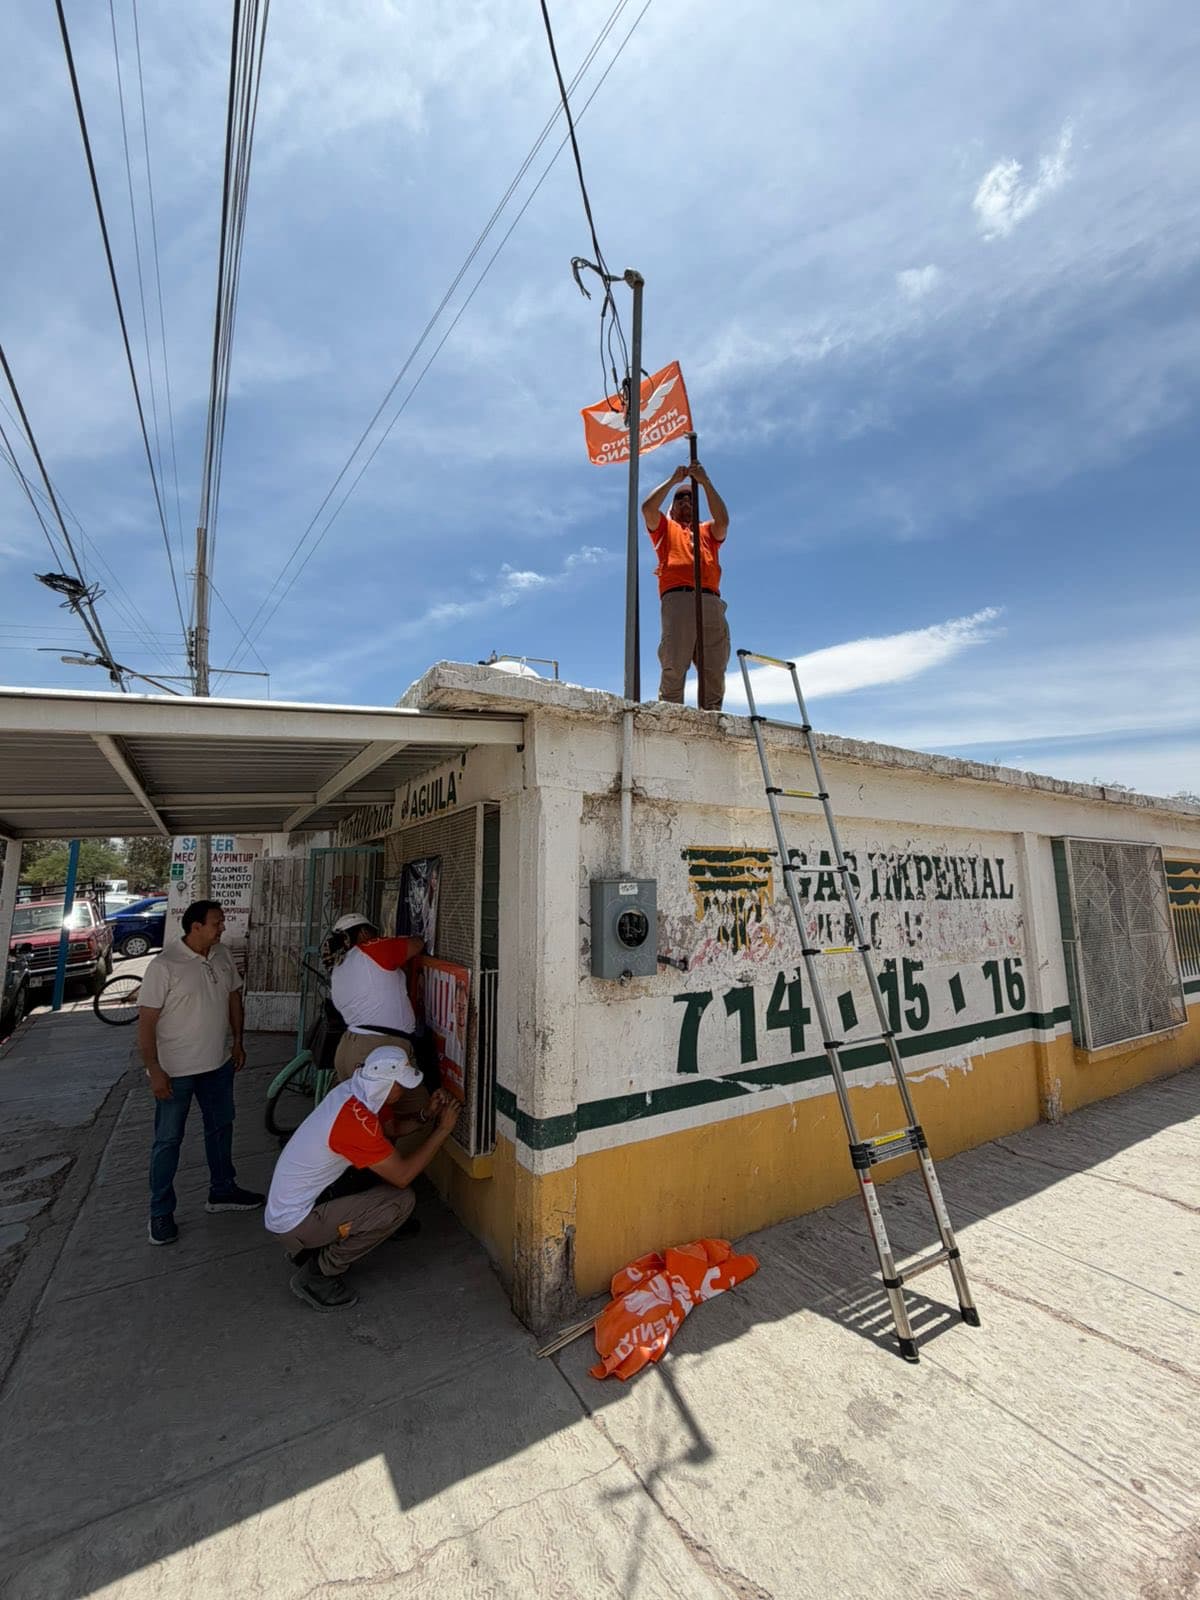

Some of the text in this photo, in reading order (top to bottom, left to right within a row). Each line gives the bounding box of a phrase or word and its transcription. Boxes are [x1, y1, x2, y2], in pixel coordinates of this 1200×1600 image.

[868, 850, 1014, 901] IMPERIAL
[673, 966, 811, 1074] 714
[877, 957, 930, 1035] 15
[982, 957, 1026, 1015] 16
